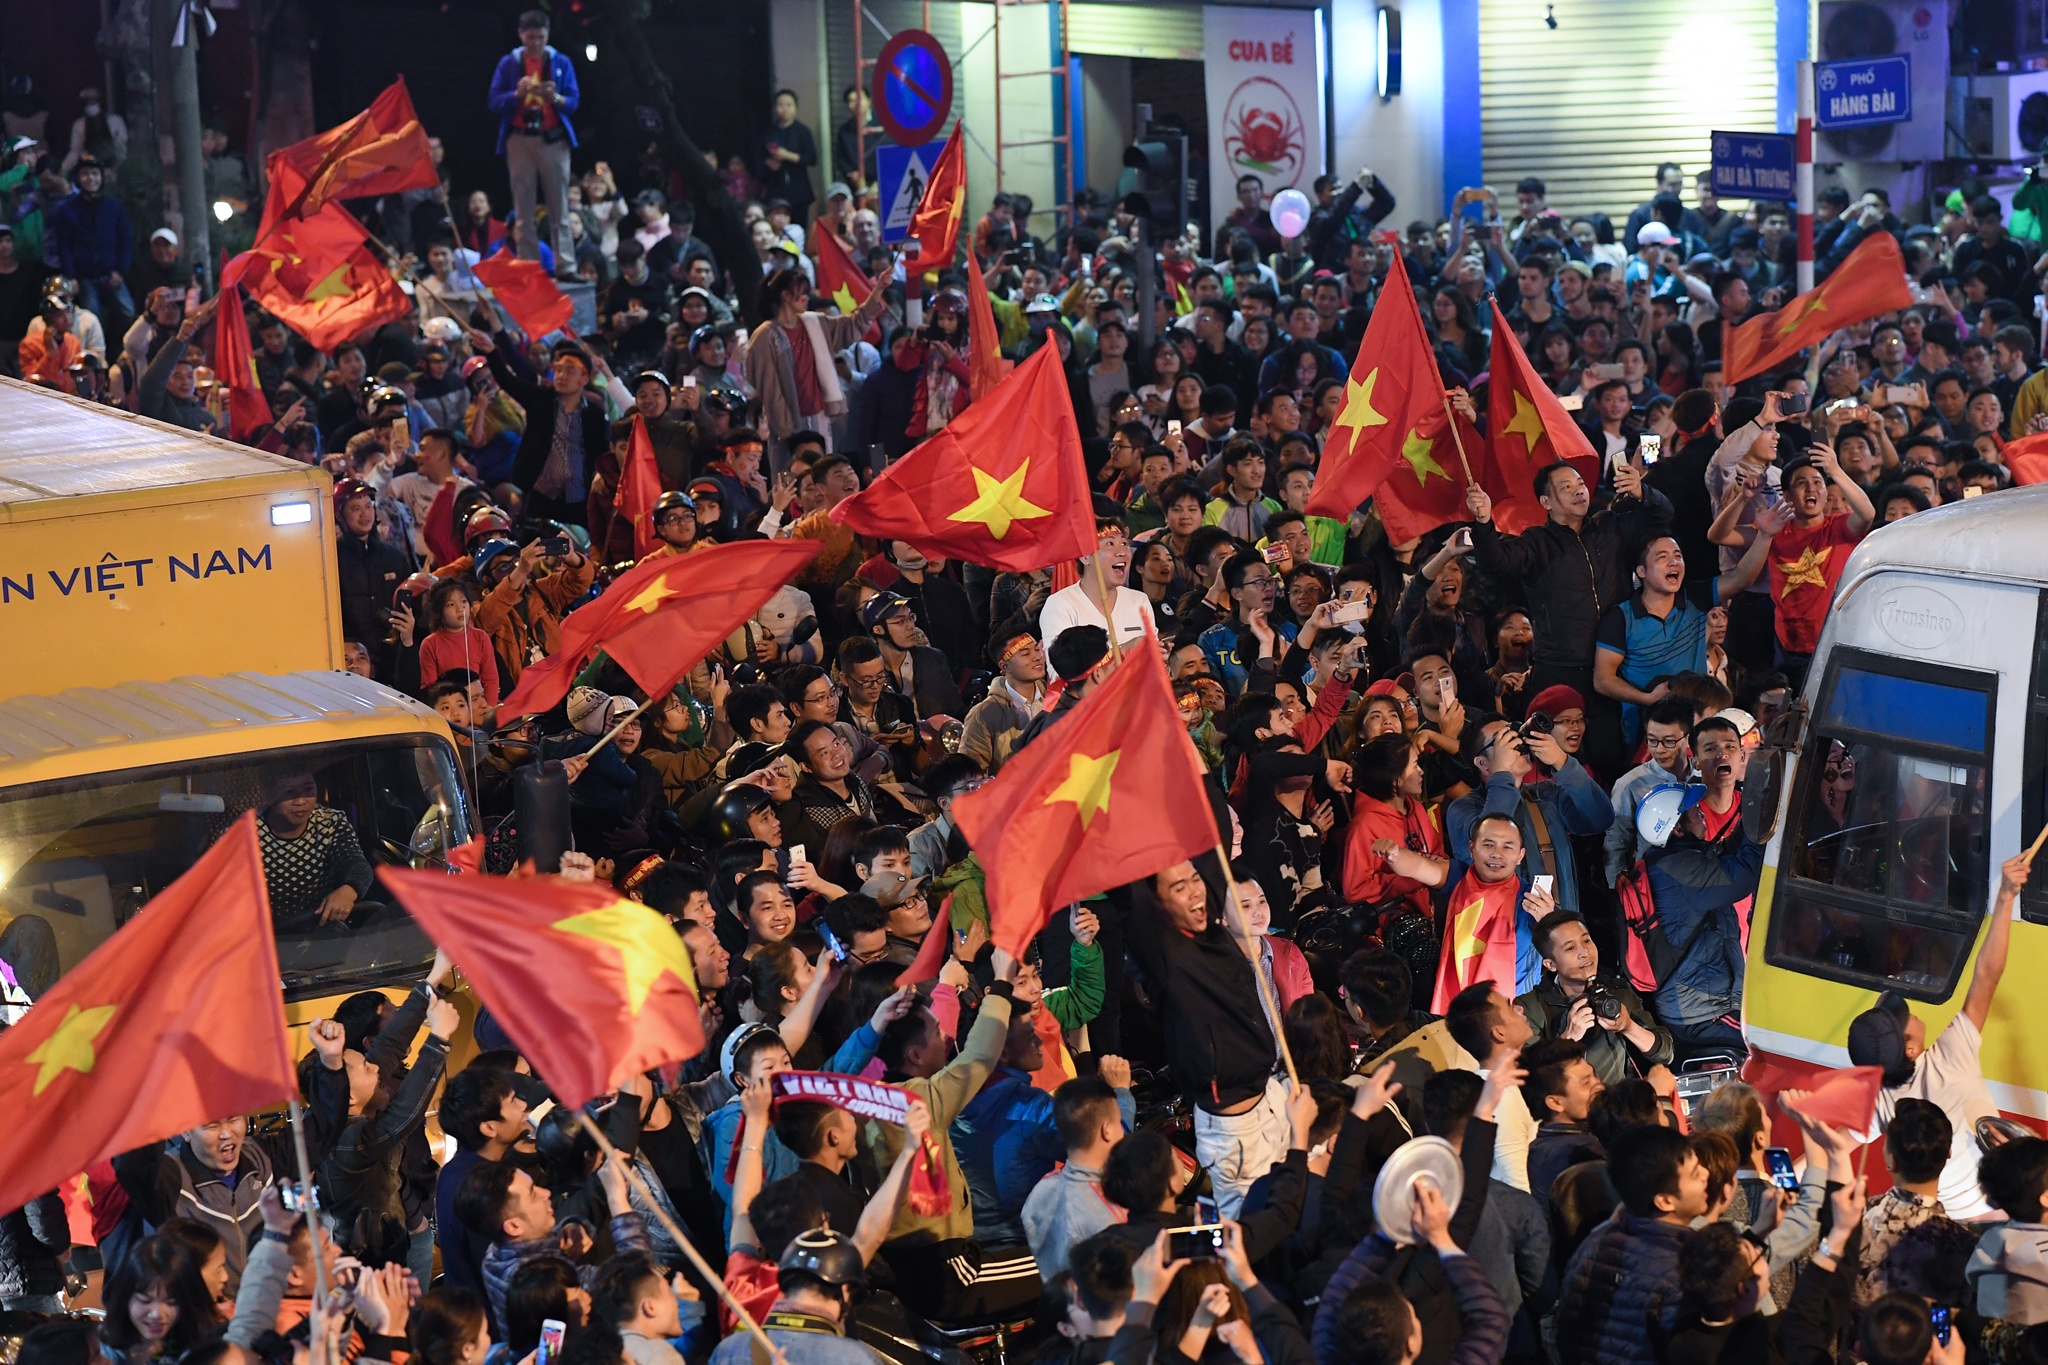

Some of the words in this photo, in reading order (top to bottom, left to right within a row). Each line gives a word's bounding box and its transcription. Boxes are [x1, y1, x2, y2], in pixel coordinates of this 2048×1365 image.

[1229, 39, 1267, 61] CUA
[1850, 66, 1875, 86] PHỐ
[1830, 92, 1869, 117] HÀNG
[1872, 87, 1895, 113] BÀI
[1741, 142, 1764, 158] PHỐ
[1716, 165, 1735, 186] HAI
[1737, 163, 1752, 187] BÀ
[1754, 167, 1790, 190] TRƯNG
[48, 551, 153, 601] VIỆT
[168, 543, 272, 582] NAM
[779, 1073, 910, 1112] VIETNAM
[845, 1098, 906, 1124] SUPPORTE
